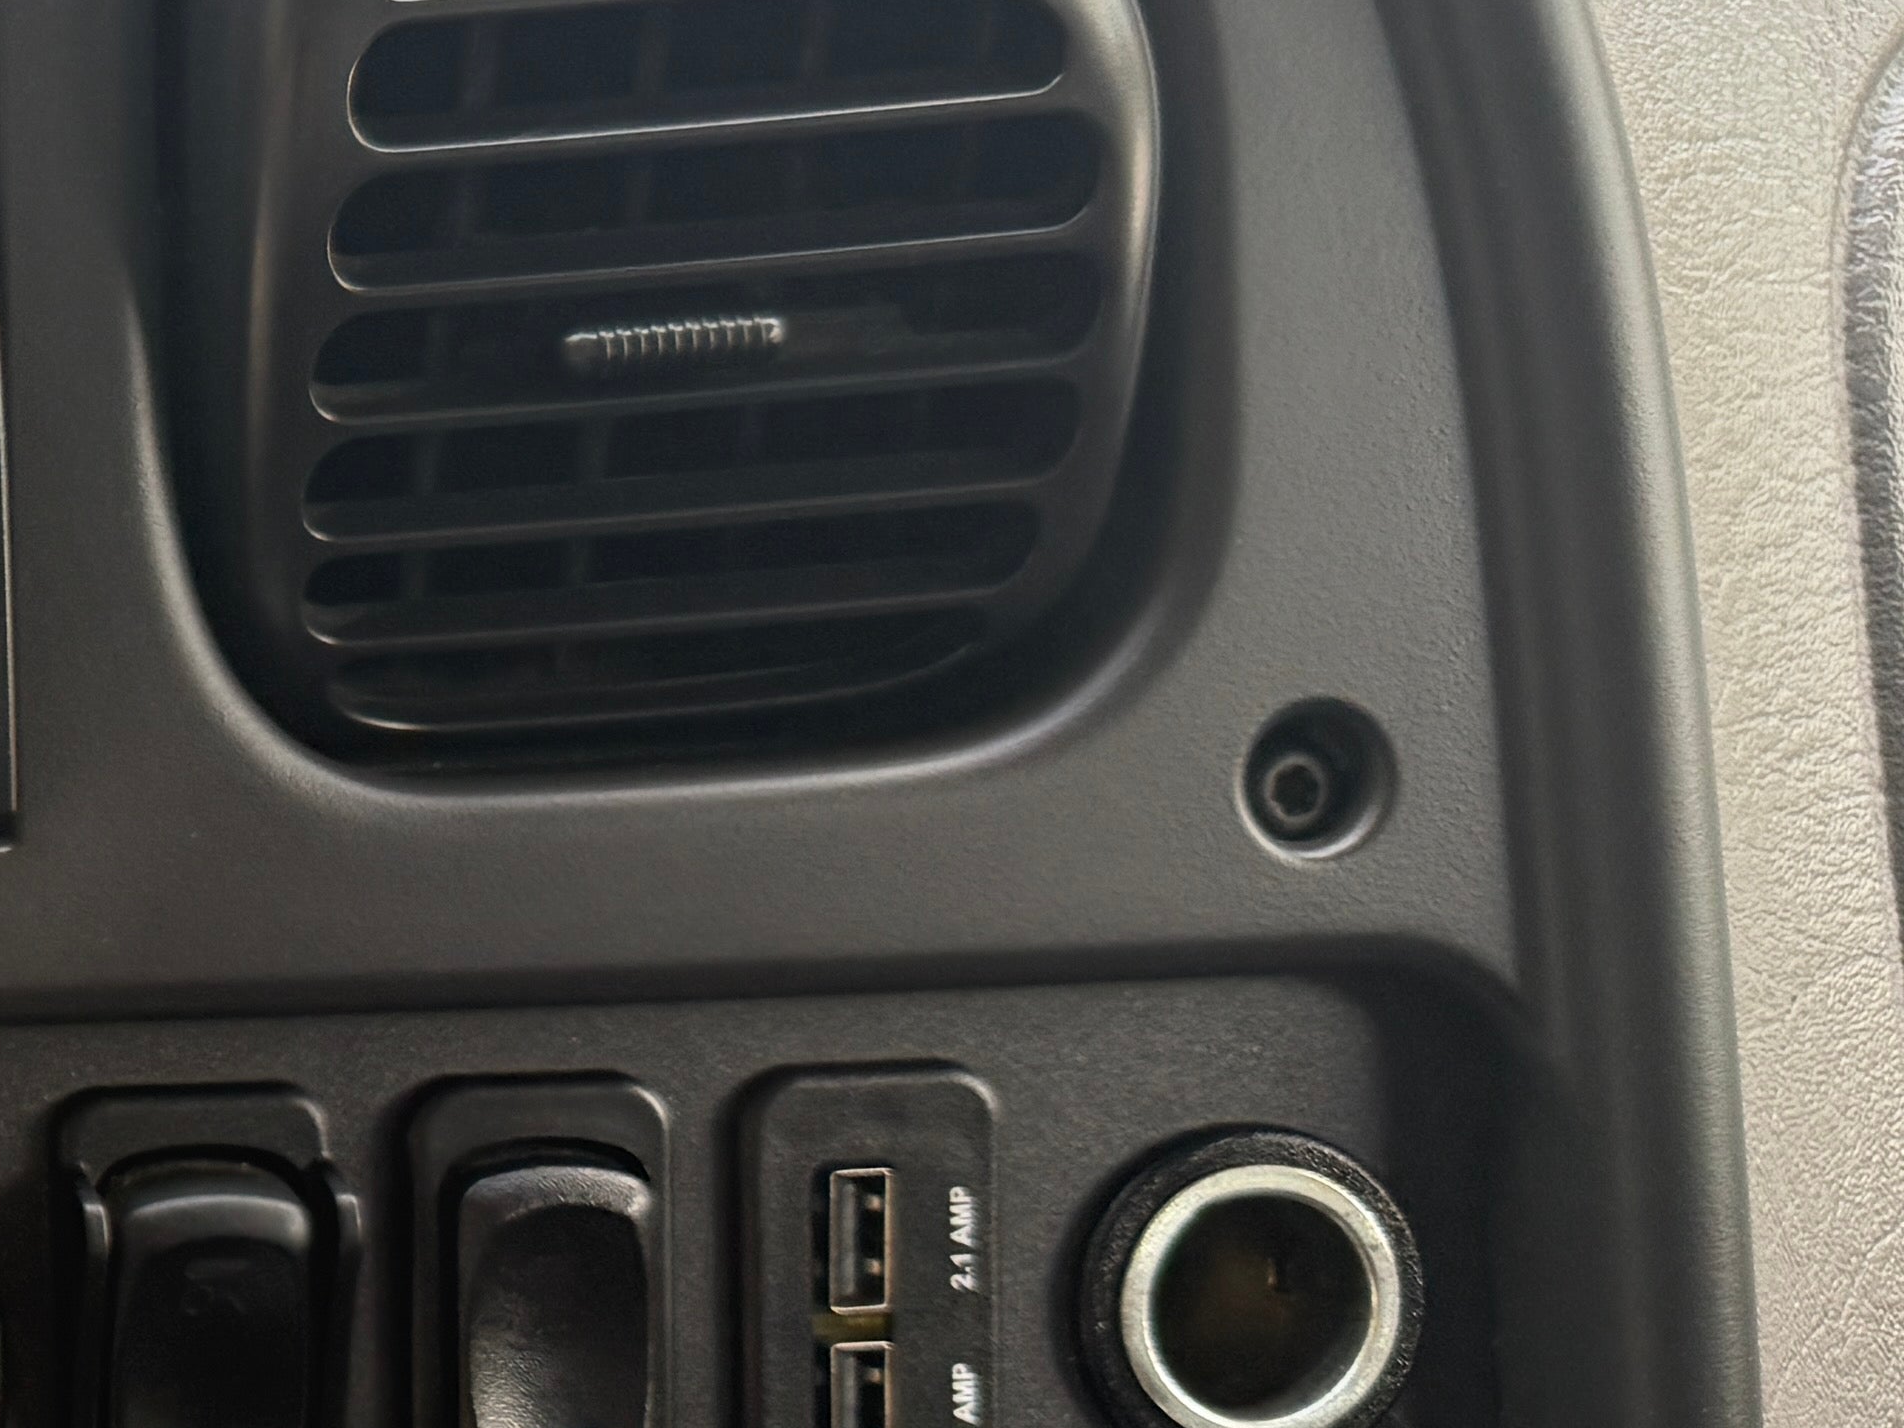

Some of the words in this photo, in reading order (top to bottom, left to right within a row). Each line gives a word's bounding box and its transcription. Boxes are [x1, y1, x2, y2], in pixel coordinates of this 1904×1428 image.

[949, 1185, 976, 1248] AMP
[949, 1252, 976, 1292] 2.1
[953, 1363, 980, 1426] AMP
